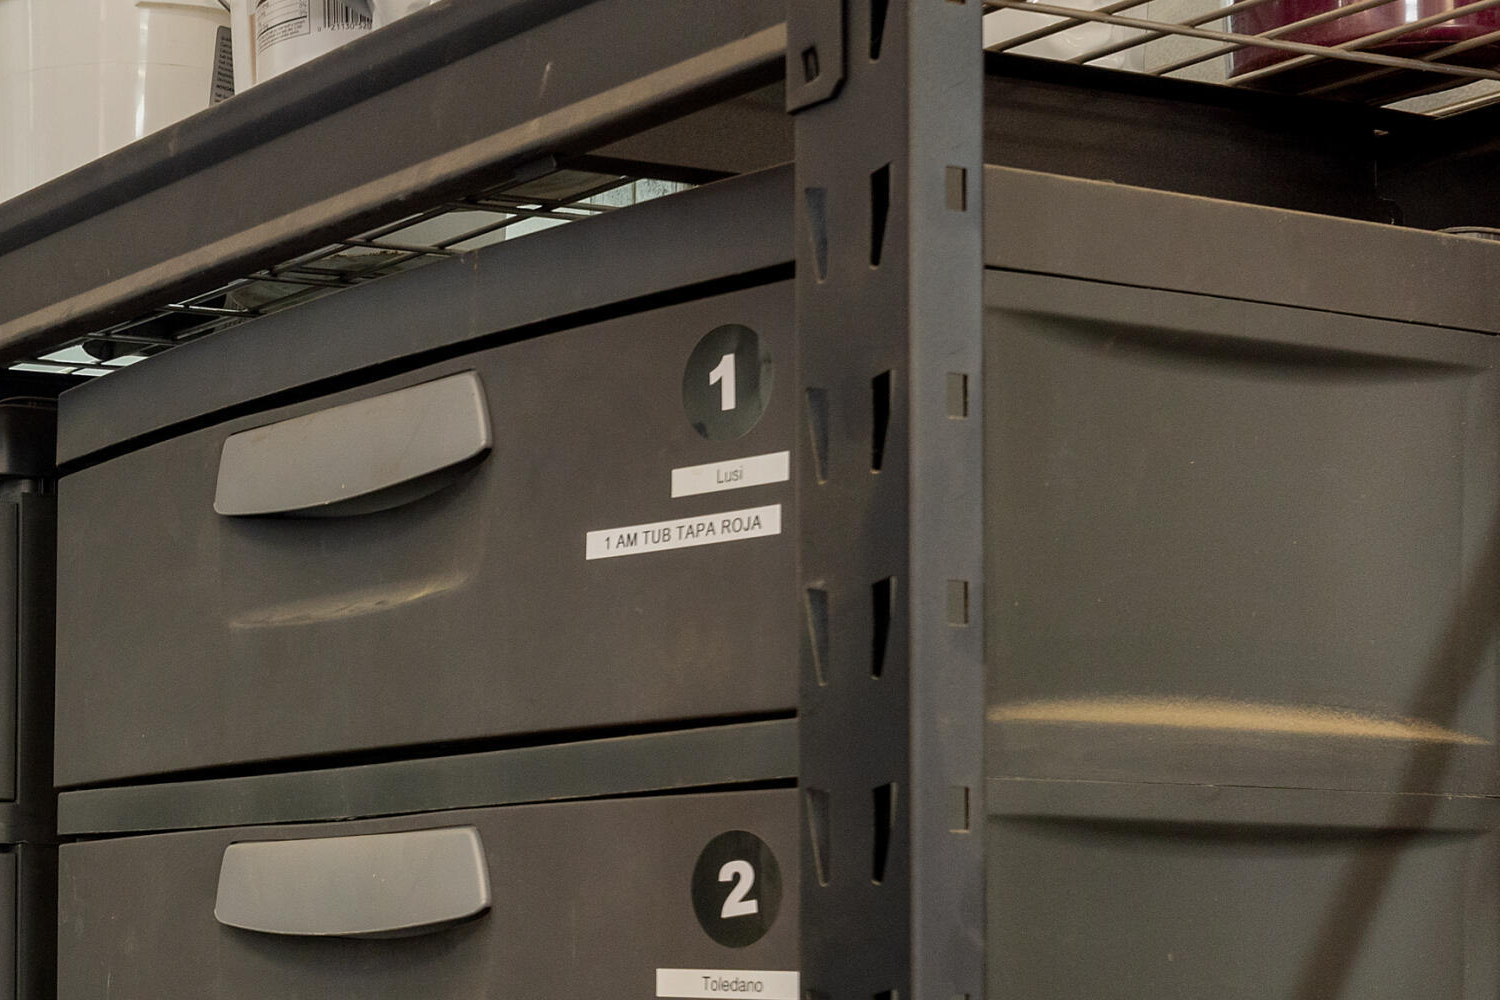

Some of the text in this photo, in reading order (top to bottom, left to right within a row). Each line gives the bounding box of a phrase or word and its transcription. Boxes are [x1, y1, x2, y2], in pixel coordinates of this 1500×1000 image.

[708, 352, 737, 412] 1
[716, 465, 744, 484] Lusi
[604, 514, 762, 550] 1 AM TUB TAPA ROJA
[717, 859, 759, 919] 2
[701, 976, 764, 993] Toledano
